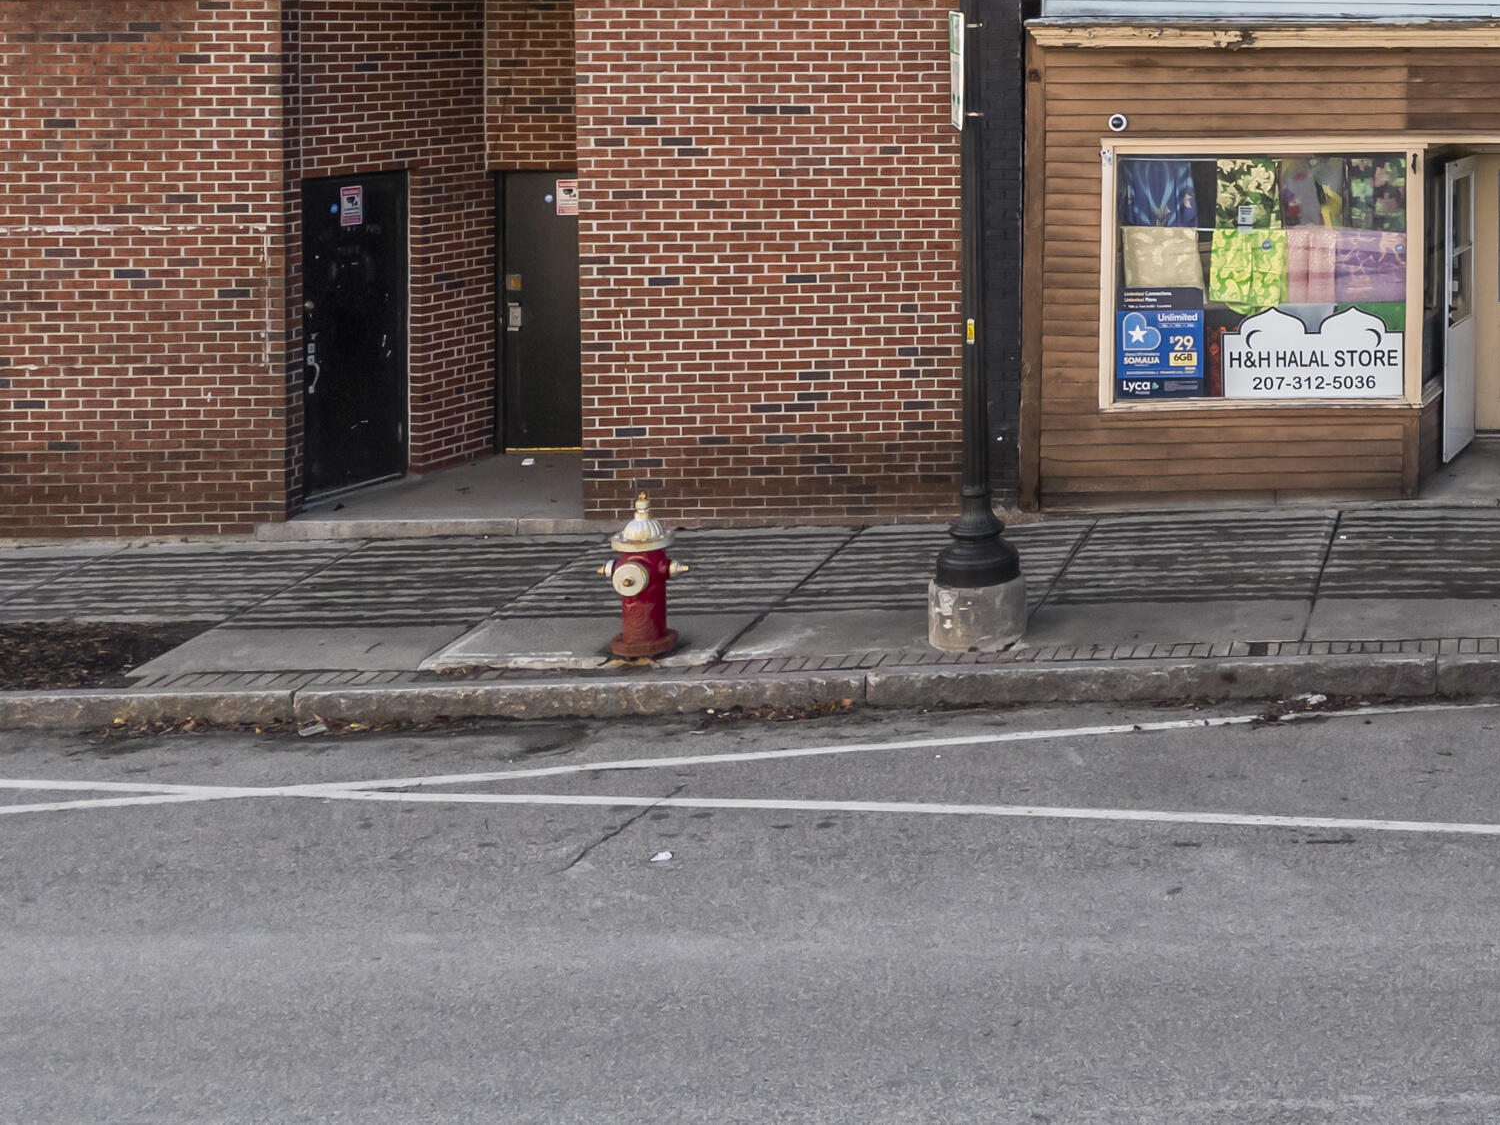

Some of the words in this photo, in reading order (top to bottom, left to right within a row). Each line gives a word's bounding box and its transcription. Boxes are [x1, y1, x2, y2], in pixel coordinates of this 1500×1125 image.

[1157, 312, 1198, 322] Unlimited
[1169, 336, 1194, 351] $29
[1123, 356, 1160, 365] SOMALIA
[1173, 353, 1193, 361] 6GB
[1229, 350, 1271, 369] H&H
[1275, 350, 1330, 368] HALAL
[1334, 349, 1399, 368] STORE
[1123, 380, 1151, 393] Lyca
[1252, 375, 1376, 391] 207-312-5036
